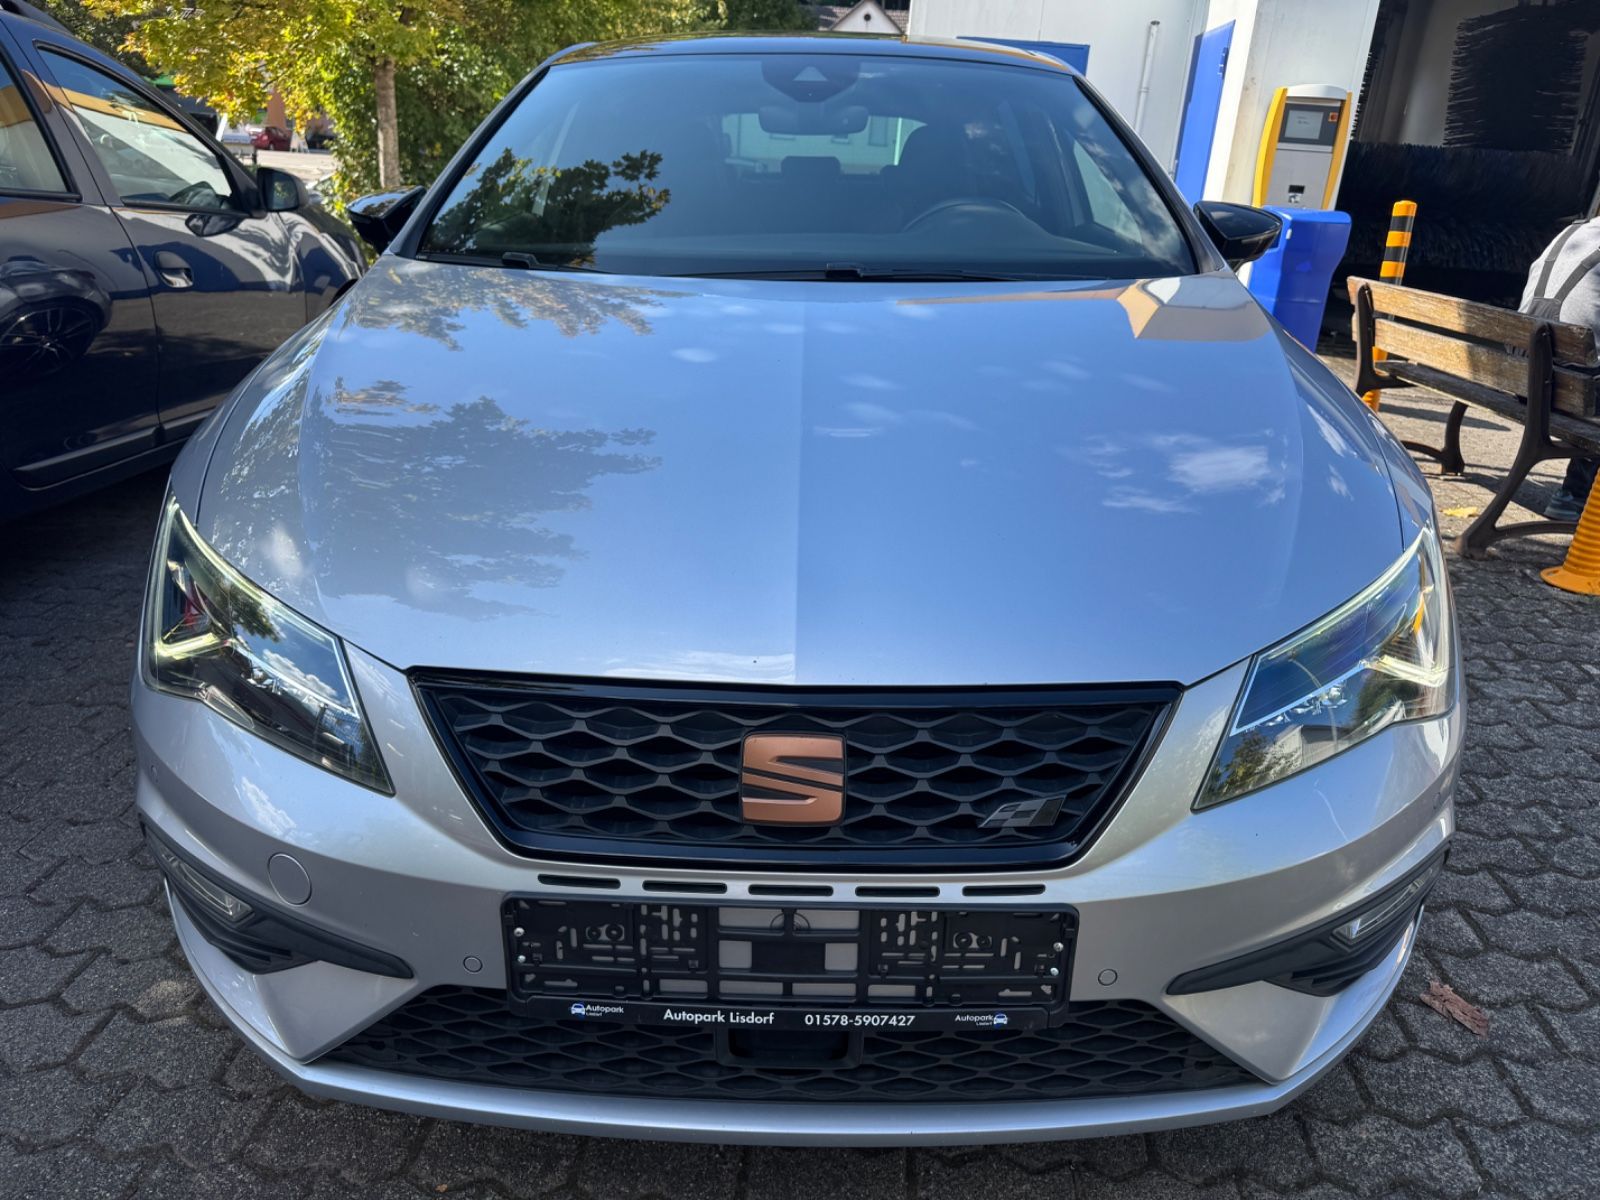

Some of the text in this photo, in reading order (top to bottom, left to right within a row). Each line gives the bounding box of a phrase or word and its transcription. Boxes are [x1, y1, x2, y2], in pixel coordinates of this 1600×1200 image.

[585, 1004, 625, 1014] Autopark
[663, 1008, 775, 1025] Autopark Lisdorf
[804, 1014, 916, 1026] 01578-5907427
[954, 1014, 994, 1022] Autopark
